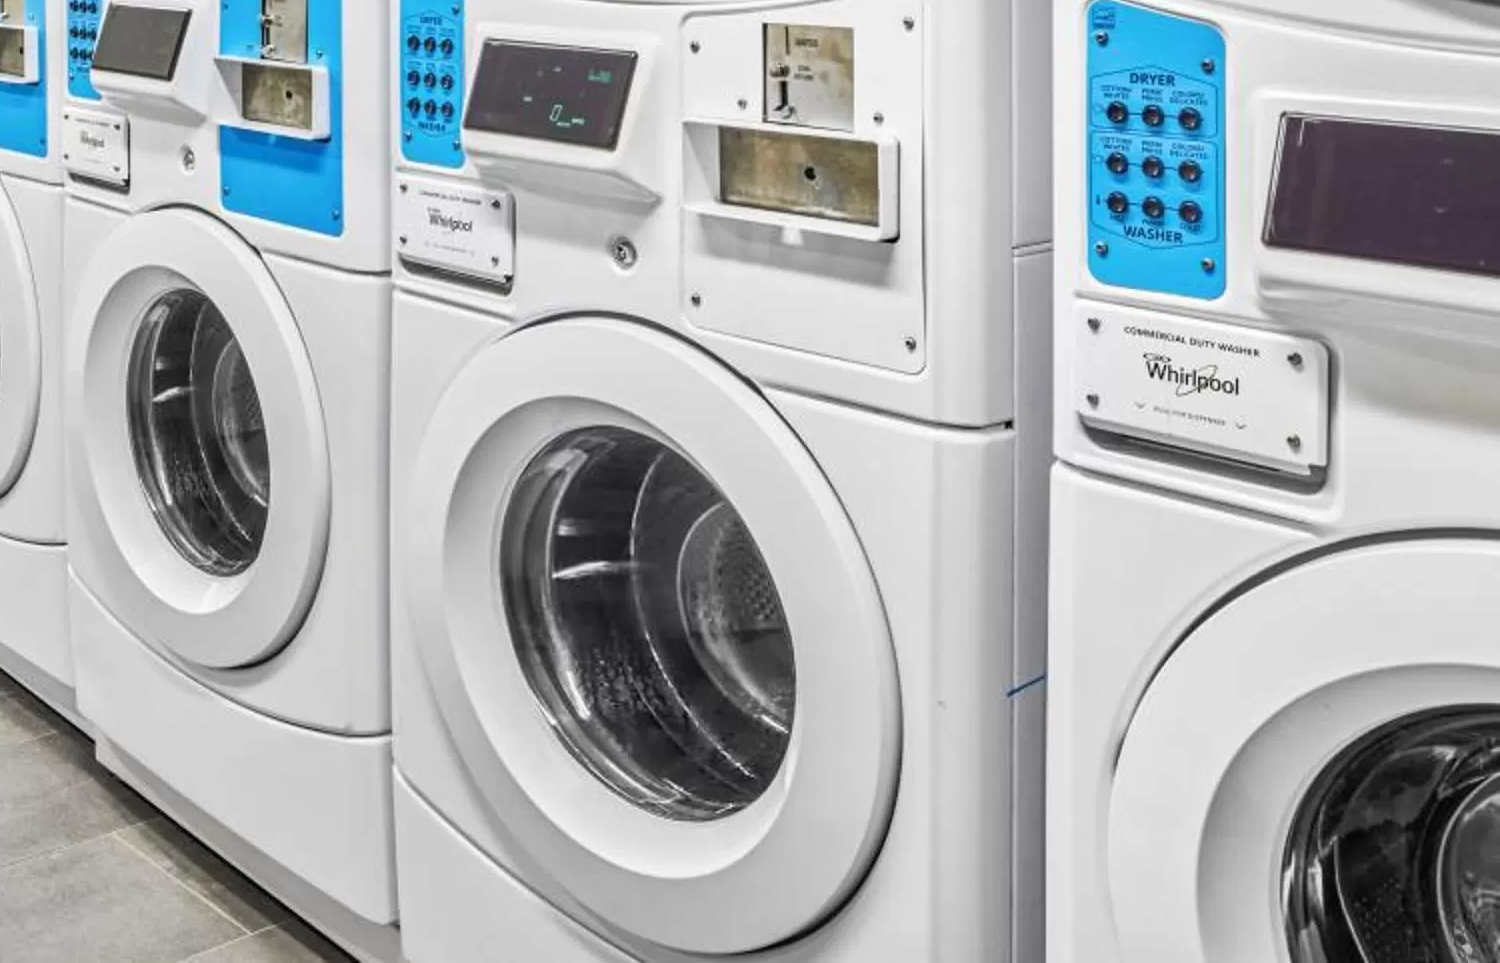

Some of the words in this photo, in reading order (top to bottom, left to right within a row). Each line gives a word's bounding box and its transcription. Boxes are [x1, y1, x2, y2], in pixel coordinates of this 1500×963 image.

[1130, 72, 1175, 86] DRYER
[1123, 225, 1183, 244] WASHER
[1123, 325, 1186, 345] COMMERCIAL
[1189, 337, 1217, 349] DUTY
[1217, 342, 1261, 358] WASHER
[1145, 360, 1240, 397] Whirlpool
